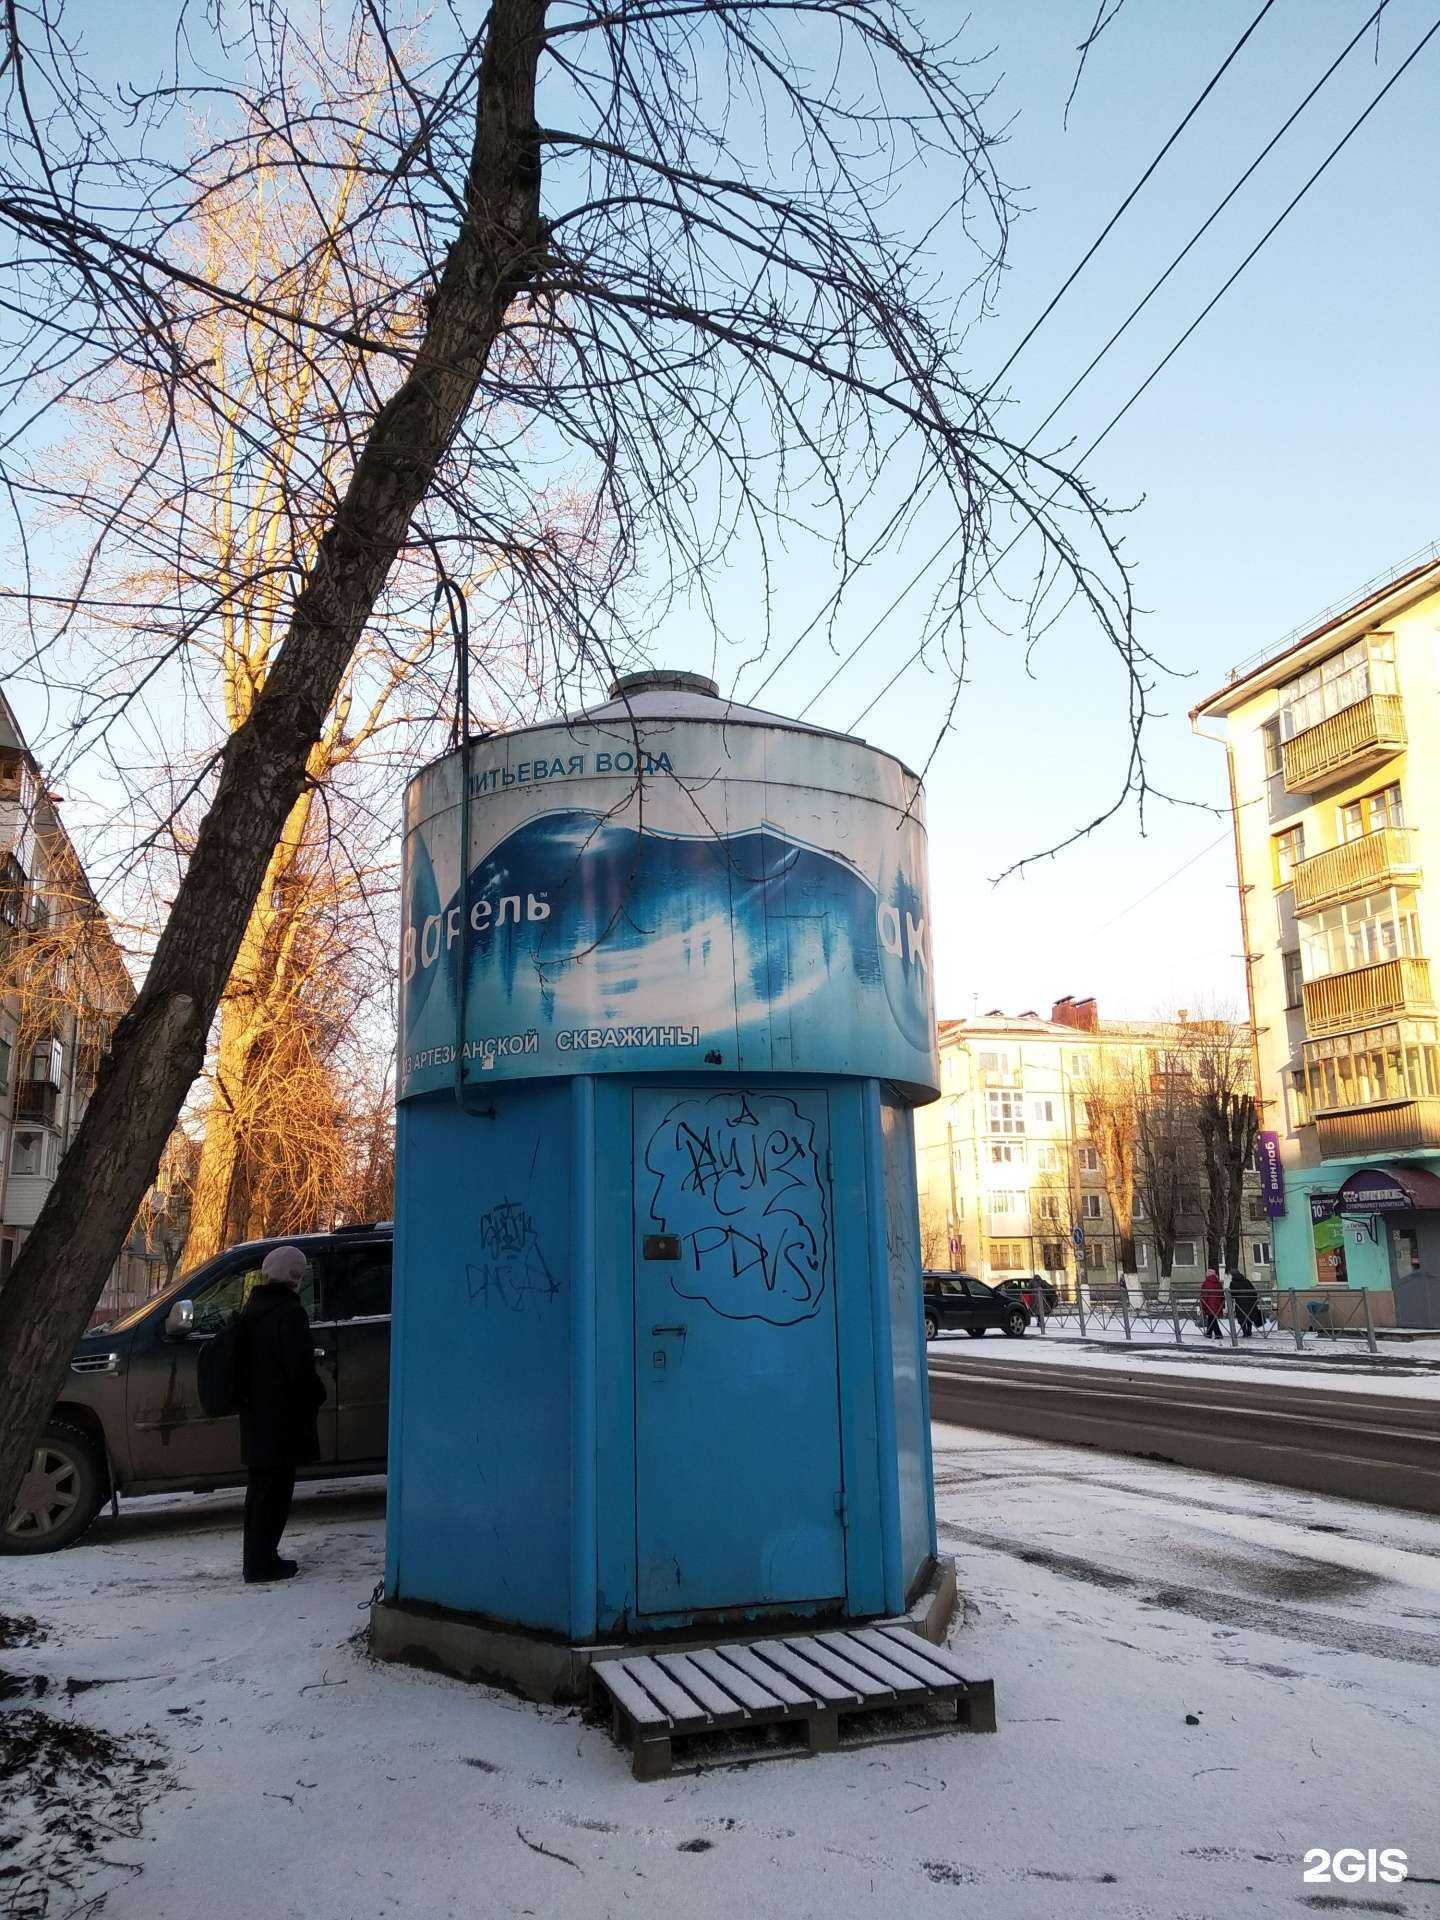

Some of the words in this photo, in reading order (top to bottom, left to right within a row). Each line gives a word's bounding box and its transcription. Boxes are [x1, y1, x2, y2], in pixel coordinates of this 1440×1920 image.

[596, 751, 674, 775] ВОДА
[555, 1026, 700, 1051] СКВАЖИНЫ
[1265, 1141, 1278, 1190] винлаб
